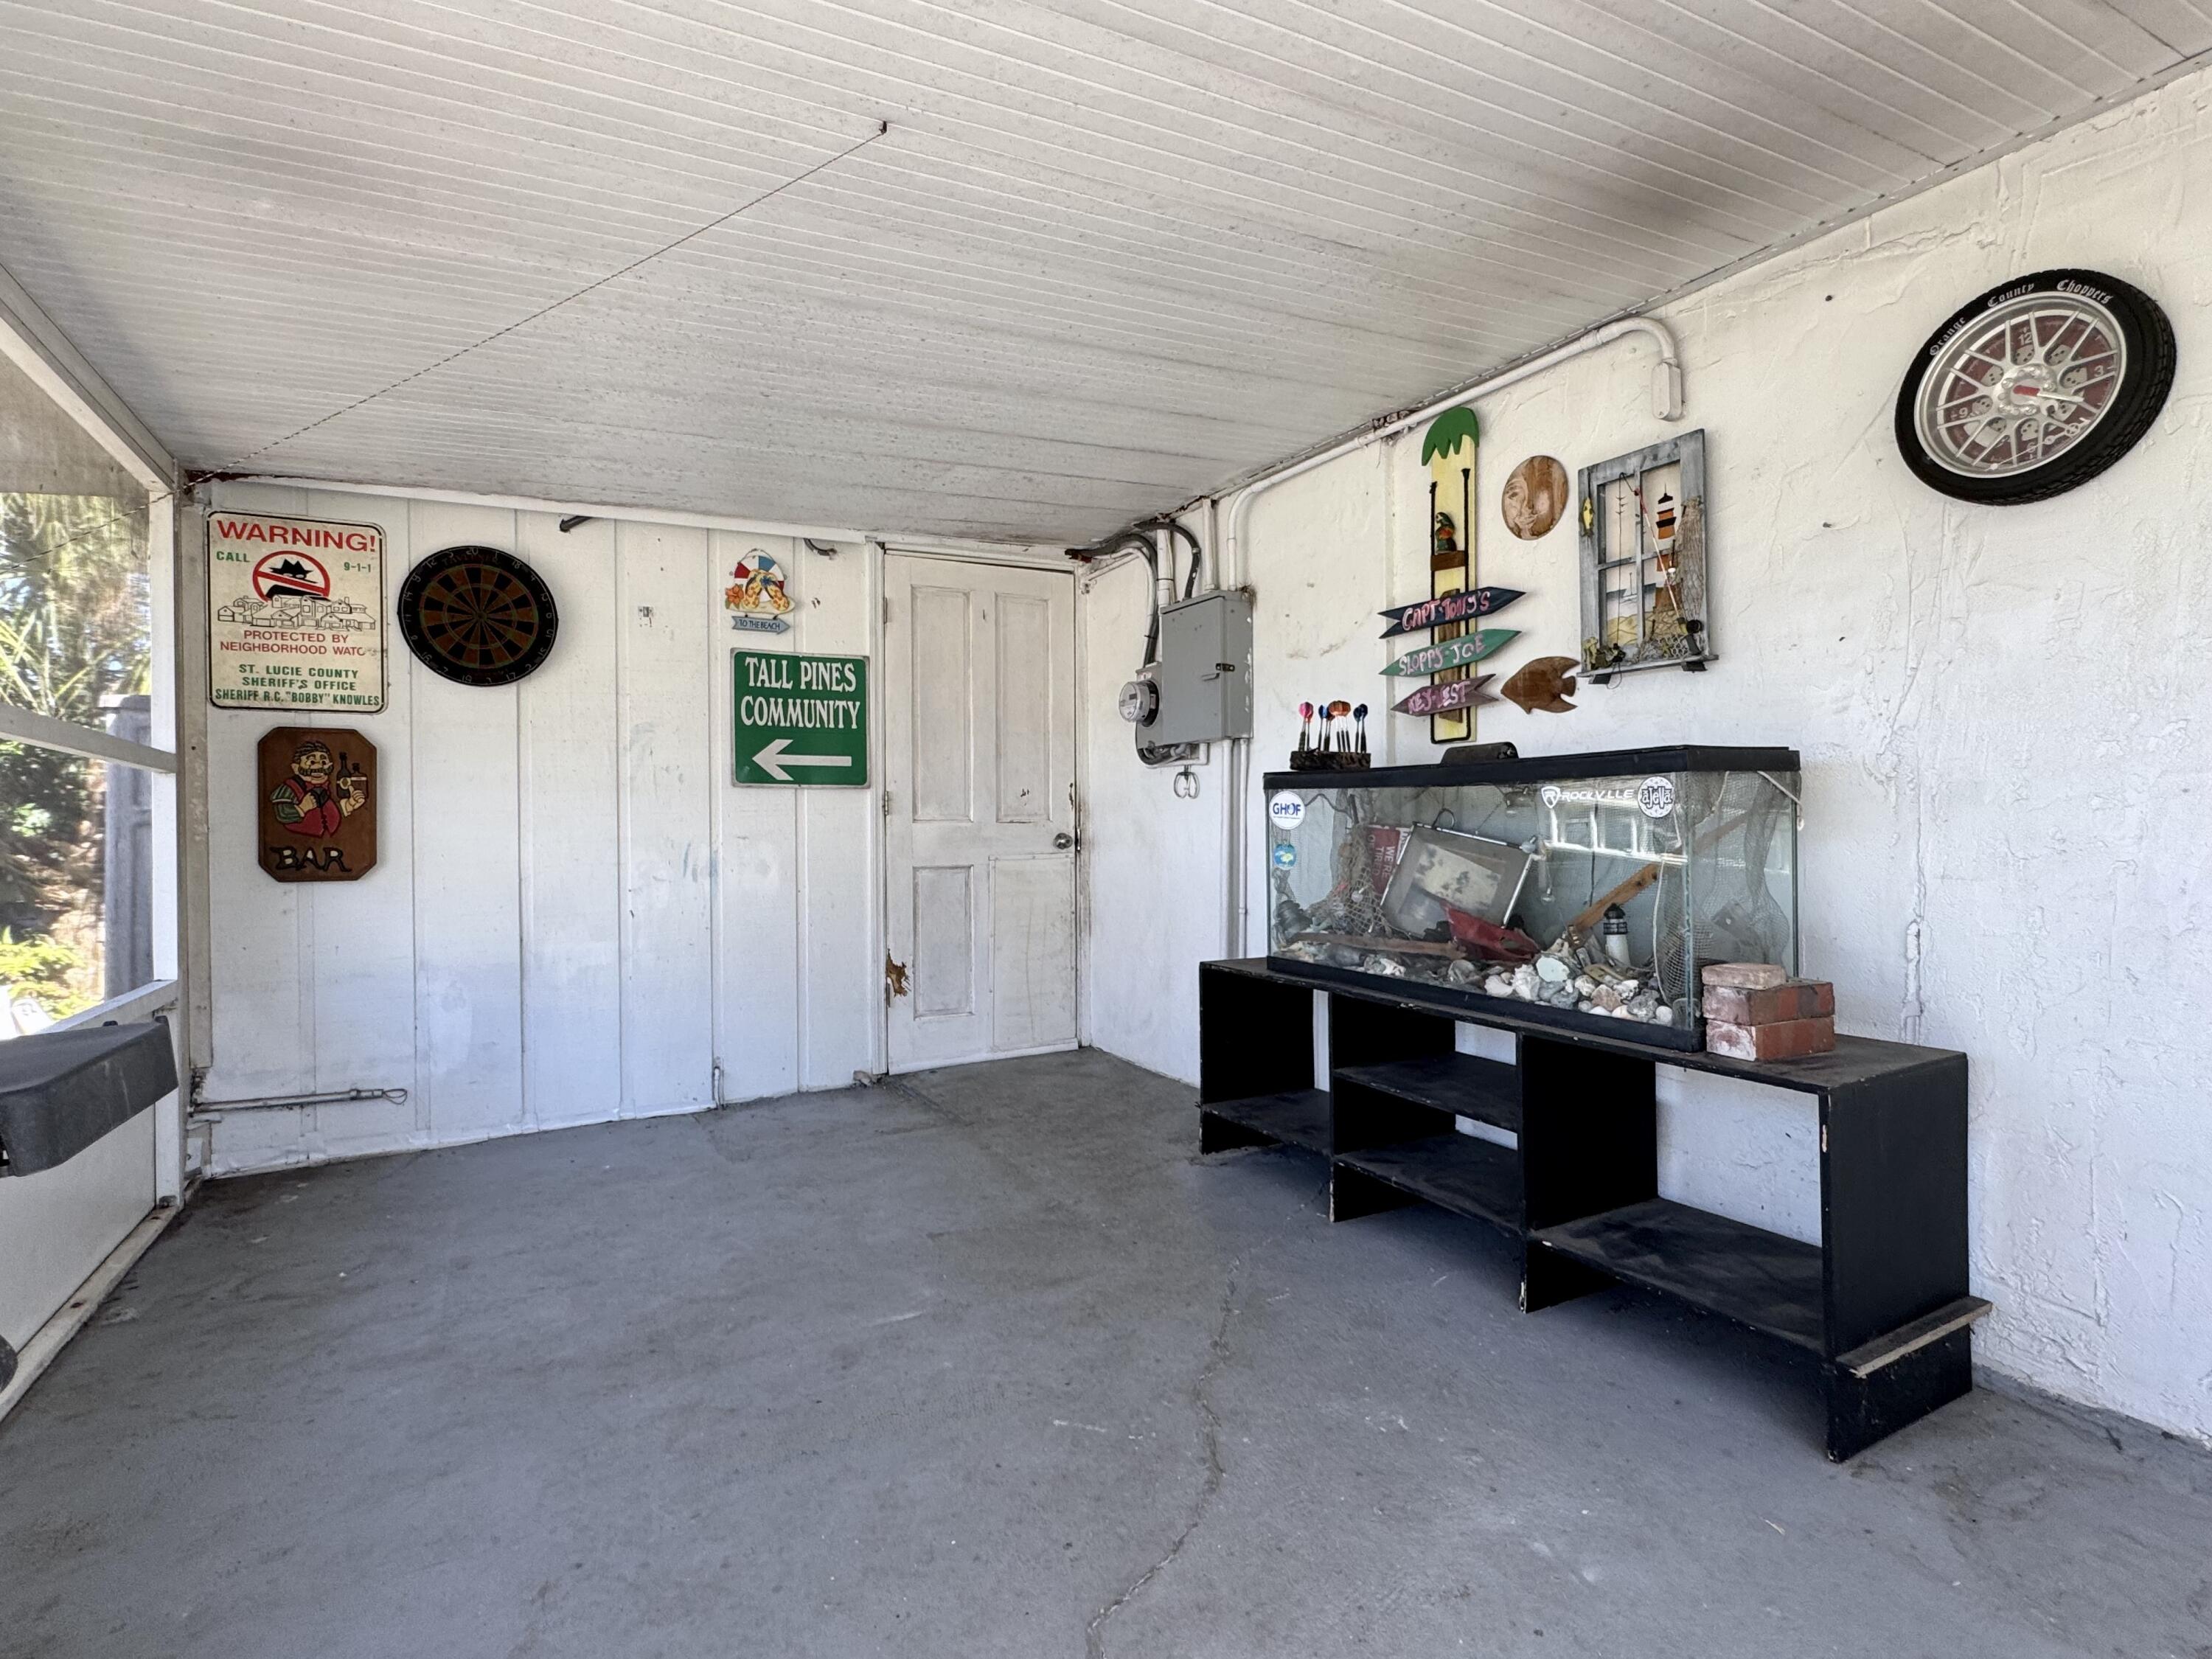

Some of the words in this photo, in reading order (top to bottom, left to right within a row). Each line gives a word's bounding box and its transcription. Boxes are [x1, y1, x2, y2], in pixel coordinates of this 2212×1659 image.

[1930, 317, 1966, 355] Orange
[1987, 282, 2034, 307] County
[2056, 279, 2114, 305] Choppers
[2094, 366, 2104, 378] 3
[1958, 408, 1969, 418] 9
[217, 519, 376, 553] WARNING!
[216, 552, 250, 563] CALL
[344, 562, 371, 573] 9-1-1
[749, 620, 761, 629] THE
[761, 621, 780, 630] BEACH
[244, 630, 325, 642] PROTECTED
[332, 634, 349, 644] BY
[220, 641, 327, 655] NEIGHBORHOOD
[333, 646, 371, 656] WATC
[266, 665, 302, 676] LUCIE
[309, 667, 358, 679] COUNTY
[745, 657, 793, 690] TALL
[800, 661, 857, 692] PINES
[242, 677, 307, 689] SHERIFF'S
[314, 681, 356, 691] OFFICE
[215, 689, 258, 701] SHERIFF
[286, 691, 330, 703] "BOBBY"
[333, 695, 380, 706] KNOWLES
[741, 695, 860, 729] COMMUNITY
[1561, 788, 1635, 802] ROCKVLLE
[1273, 803, 1301, 815] GHOF
[270, 847, 352, 872] BAR
